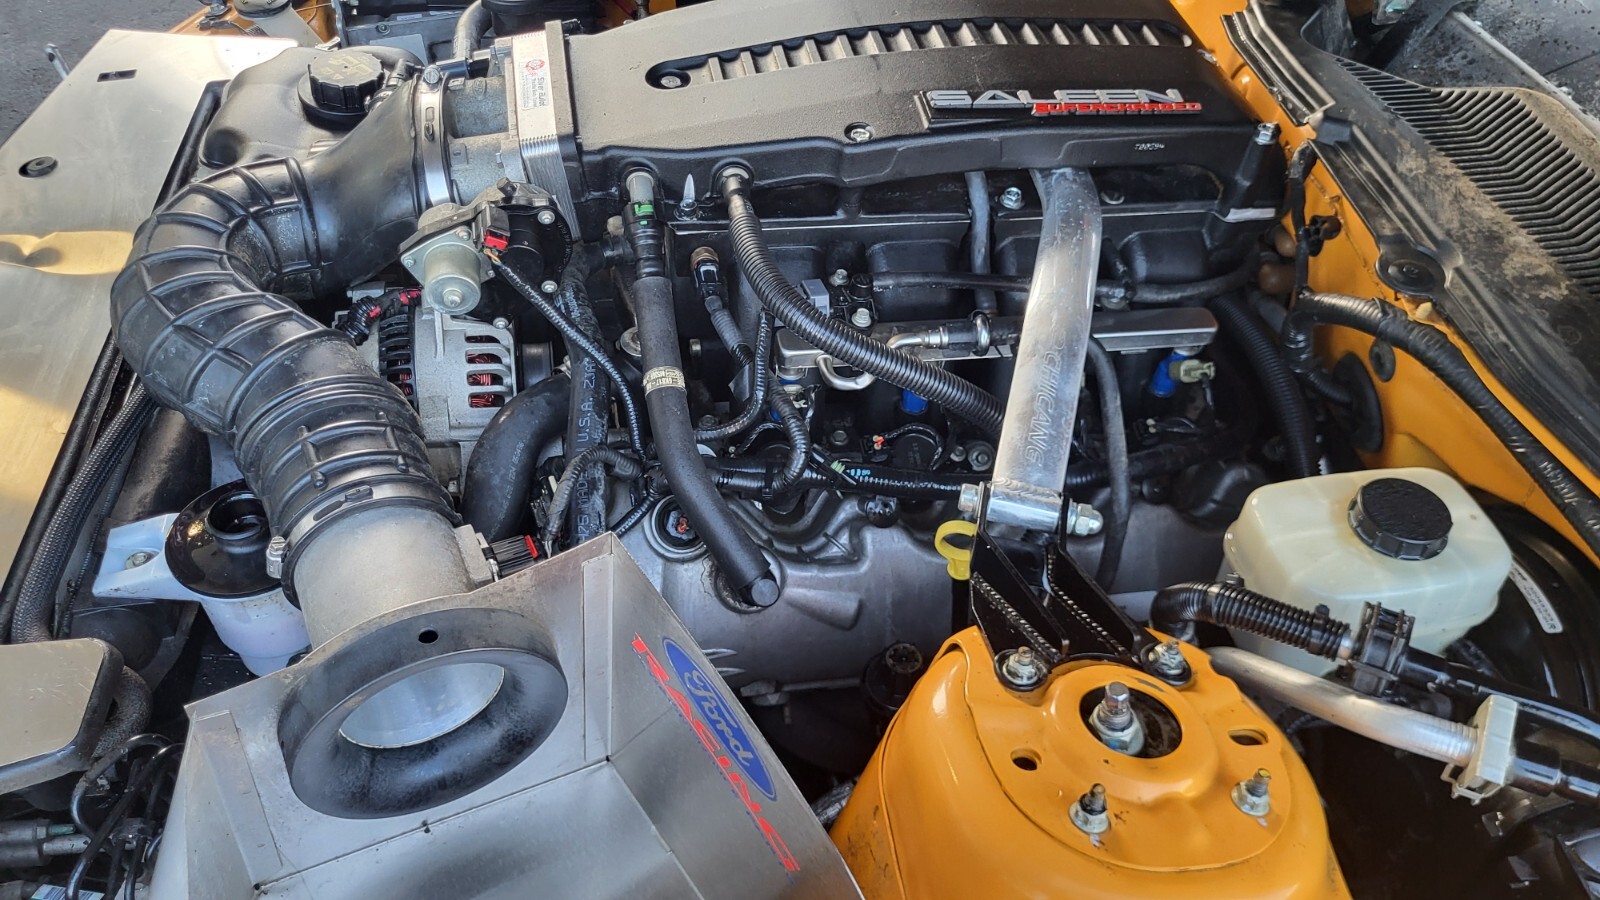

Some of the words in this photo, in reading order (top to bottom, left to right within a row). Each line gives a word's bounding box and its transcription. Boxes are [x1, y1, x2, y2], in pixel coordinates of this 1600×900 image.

[927, 89, 1184, 109] SALEEN
[1031, 102, 1202, 116] SUPERCHARGED
[576, 397, 594, 442] U.S.A.
[684, 669, 754, 766] Ford
[631, 632, 800, 871] RACING
